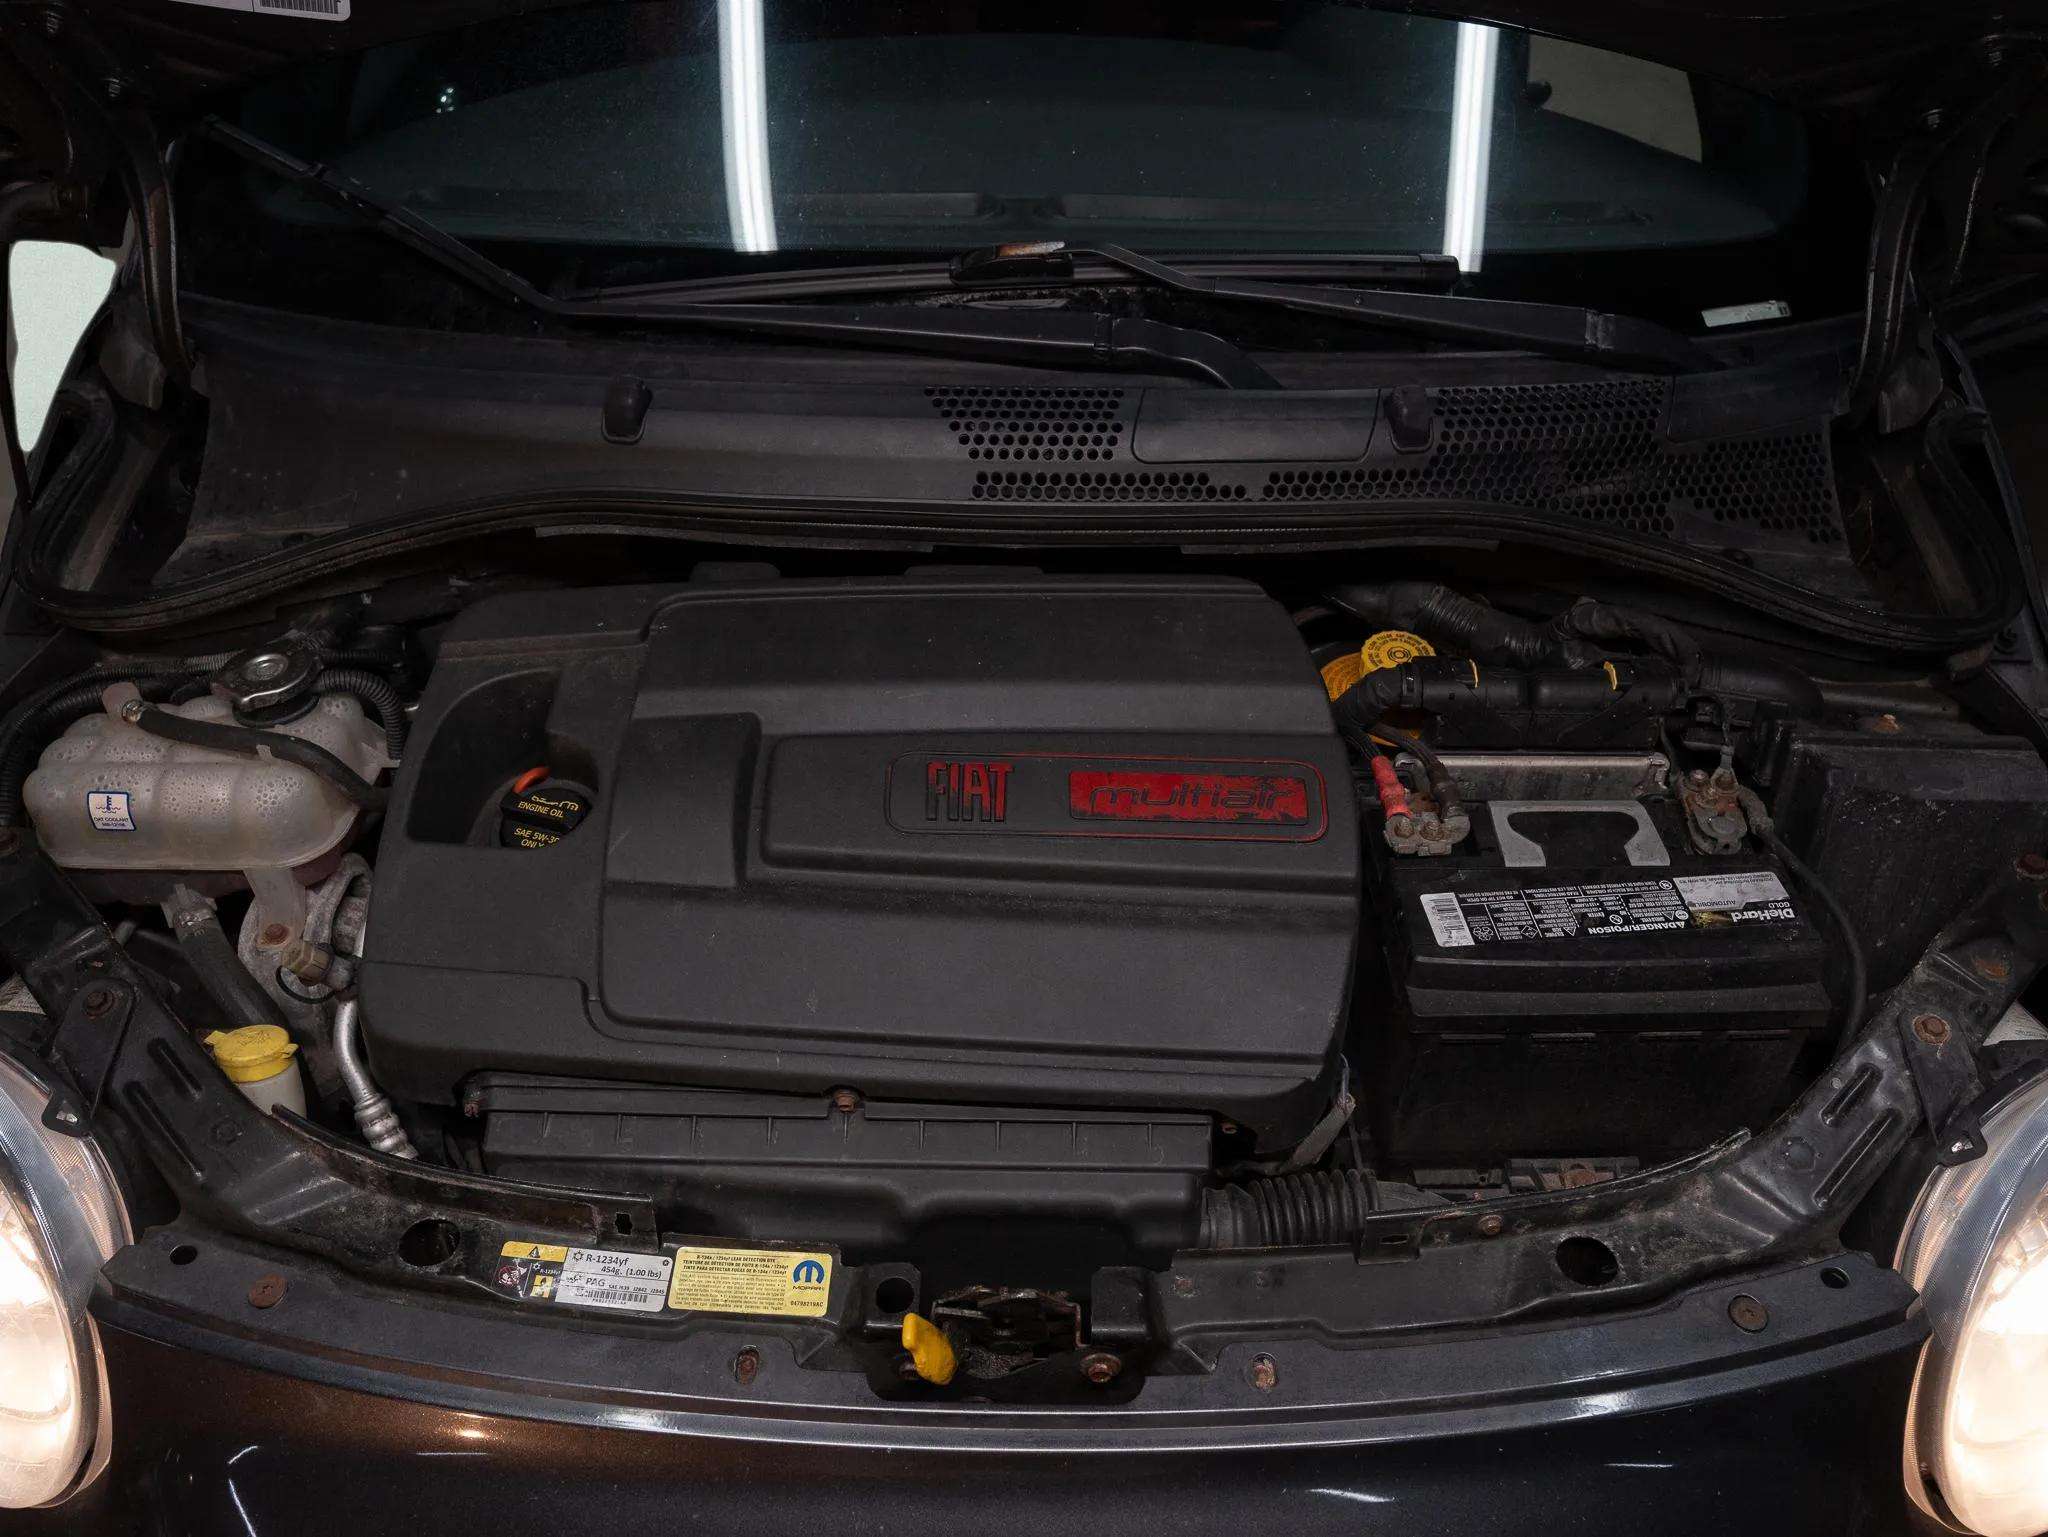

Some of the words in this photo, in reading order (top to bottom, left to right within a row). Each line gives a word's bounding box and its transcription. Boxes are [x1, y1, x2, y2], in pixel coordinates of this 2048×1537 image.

[926, 761, 1013, 823] FIAT
[1089, 783, 1293, 811] multiair
[518, 801, 550, 814] ENGINE
[550, 808, 564, 818] OIL
[514, 828, 532, 838] SAE
[1731, 908, 1795, 923] DieHard
[1588, 922, 1679, 935] DANGER/POISON
[586, 1253, 630, 1267] R-1234yf
[601, 1265, 623, 1275] 454g.
[626, 1267, 646, 1277] (1.00
[647, 1270, 662, 1279] lbs)
[586, 1277, 606, 1286] PAG
